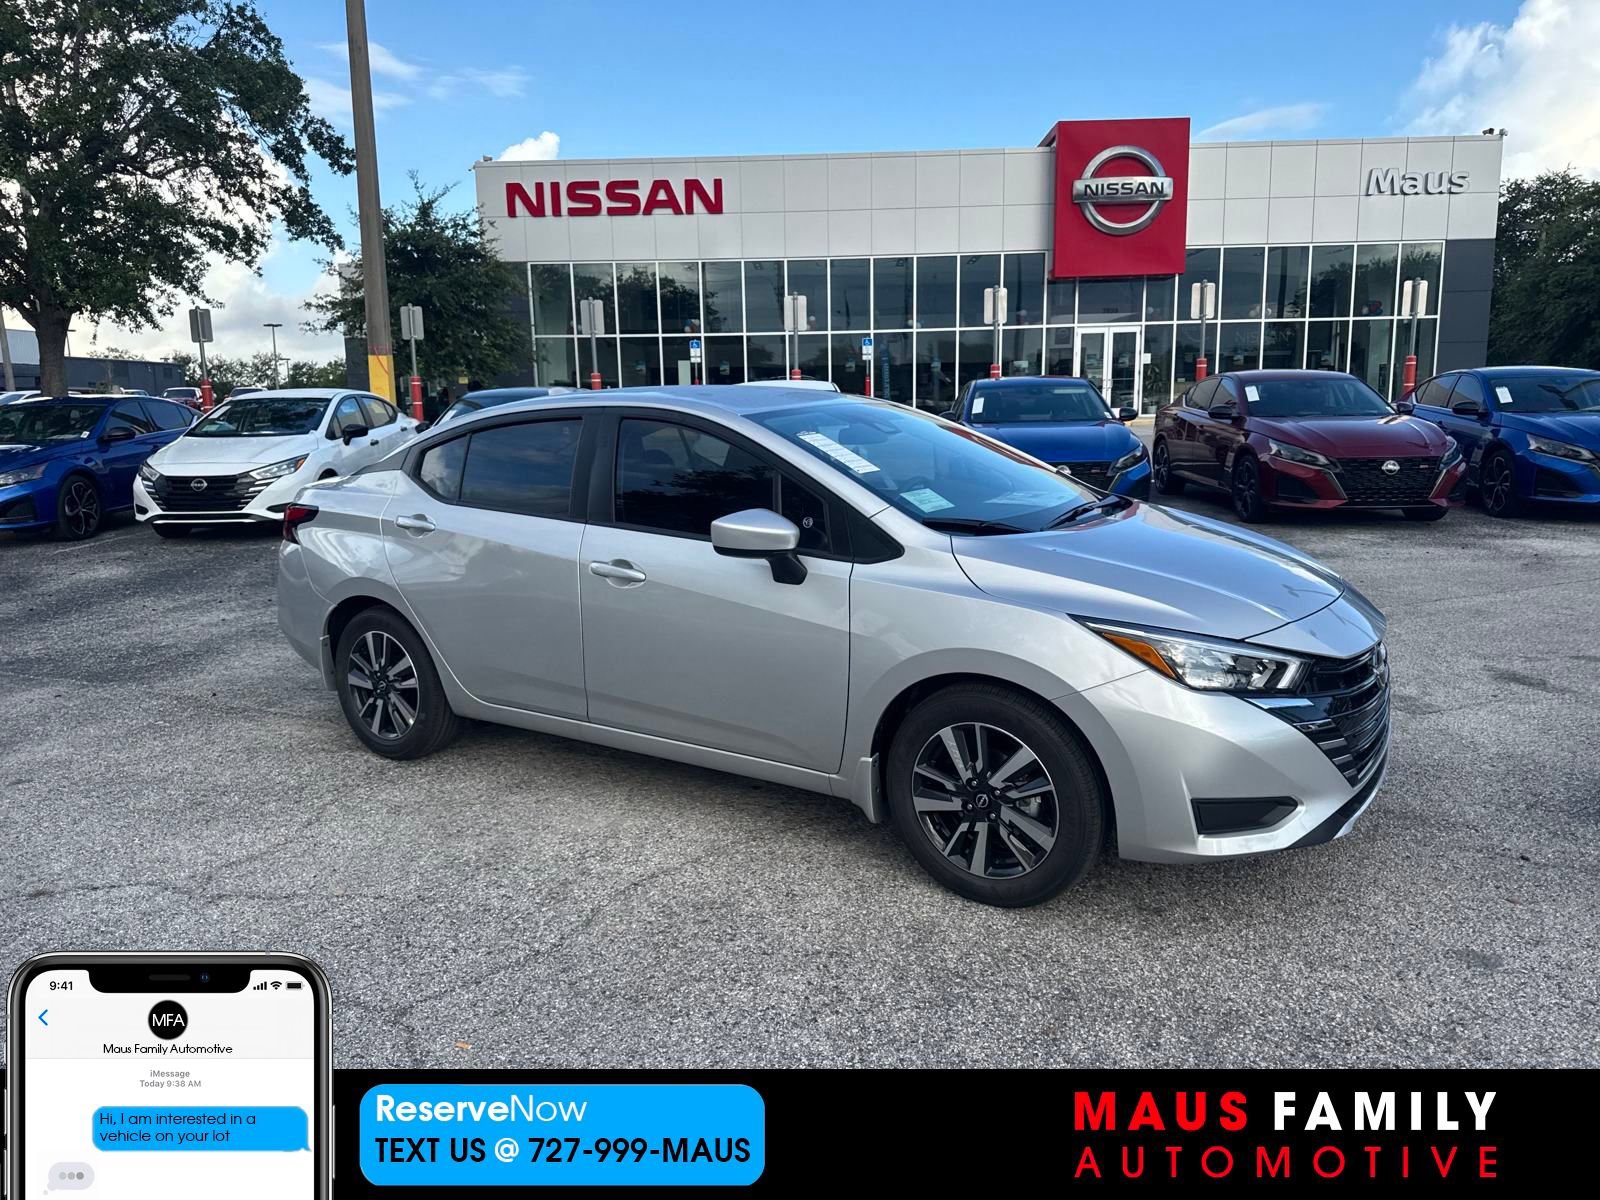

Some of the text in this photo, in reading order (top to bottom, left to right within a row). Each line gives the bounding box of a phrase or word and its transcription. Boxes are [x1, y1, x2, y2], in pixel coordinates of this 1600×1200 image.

[1084, 181, 1164, 197] NISSAN
[1365, 167, 1470, 196] Maus
[505, 178, 724, 219] NISSAN
